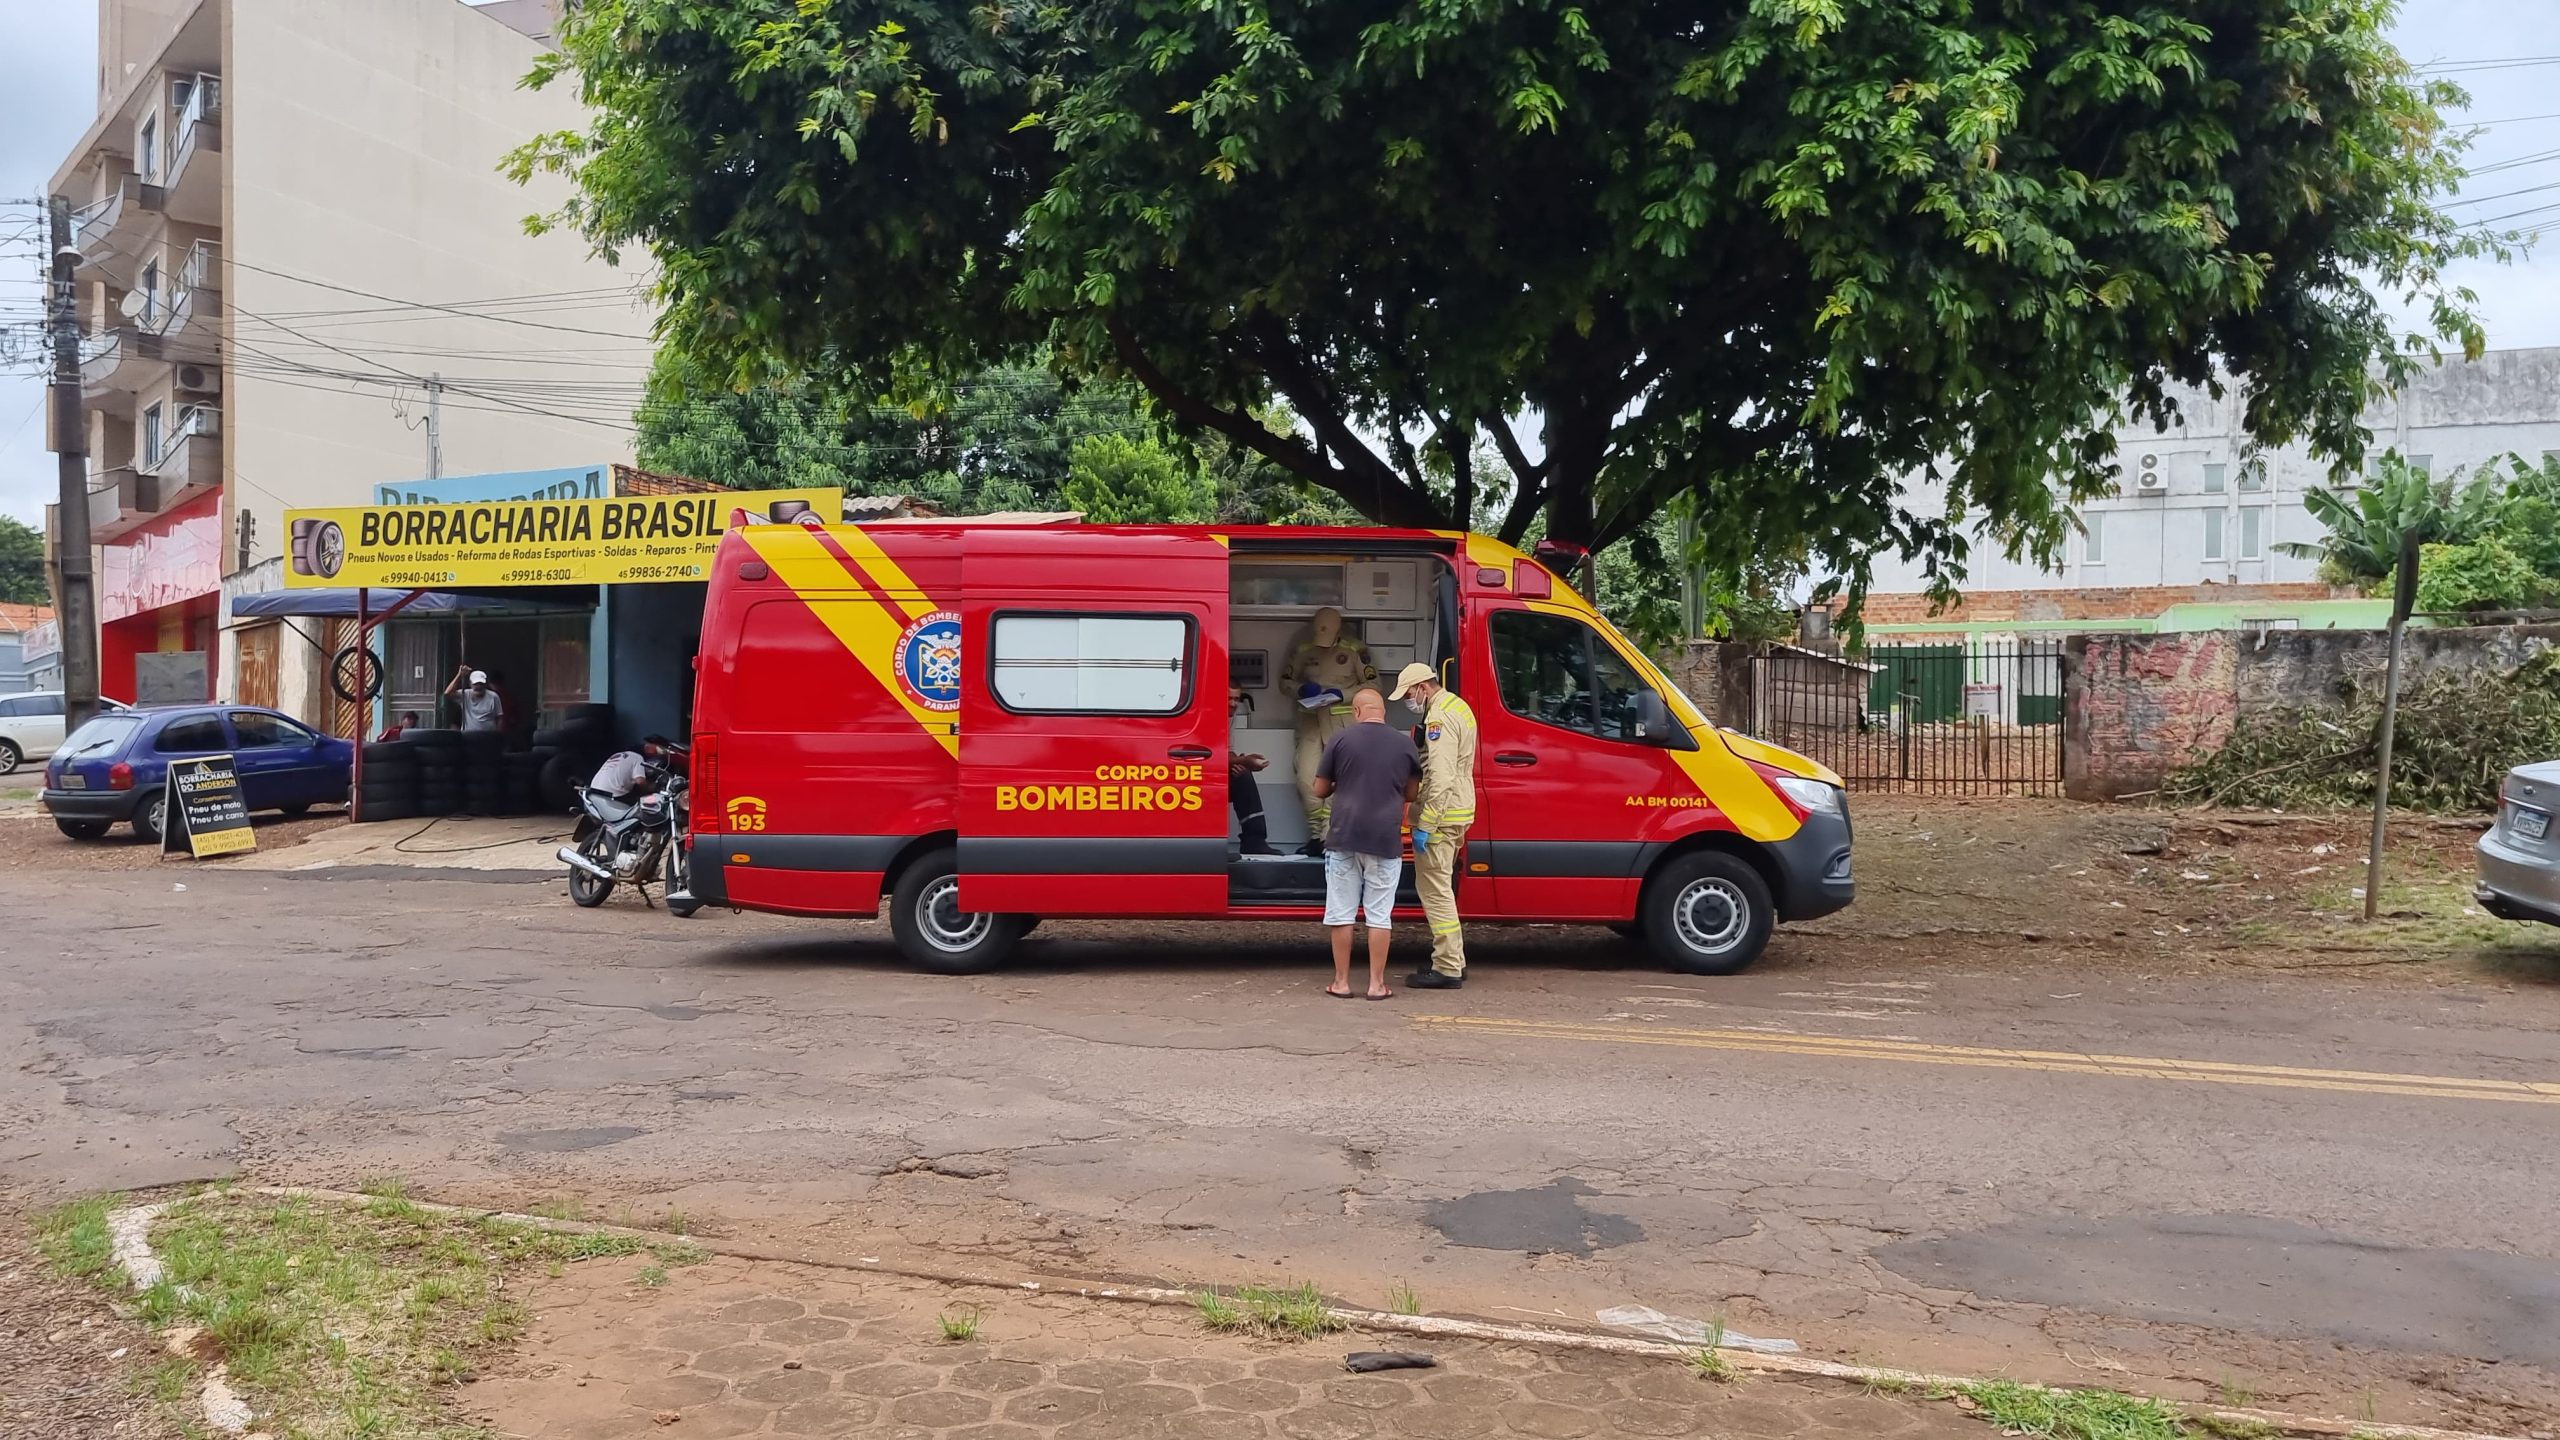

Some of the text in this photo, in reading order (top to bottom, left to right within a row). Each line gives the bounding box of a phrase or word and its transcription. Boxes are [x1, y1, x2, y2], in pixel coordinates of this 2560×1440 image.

[360, 498, 724, 546] BORRACHARIA BRASIL
[347, 552, 376, 564] Pneus
[377, 551, 406, 563] Novos
[407, 553, 414, 562] e
[415, 549, 449, 562] Usados
[456, 548, 497, 561] Reforma
[498, 549, 511, 560] de
[512, 547, 542, 560] Rodas
[544, 547, 597, 561] Esportivas
[603, 545, 638, 558] Soldas
[645, 544, 687, 558] Reparos
[380, 571, 449, 584] 45 99940-0413
[500, 568, 571, 582] 45 99918-6300
[618, 565, 692, 579] 45 99836-2740
[894, 638, 907, 676] CORPO
[905, 623, 919, 637] DE
[179, 772, 234, 784] BORRACHARIA
[1095, 765, 1203, 781] CORPO DE
[180, 779, 237, 792] DO ANDERSON
[996, 785, 1203, 811] BOMBEIROS
[1625, 796, 1708, 808] AA BM 00141
[189, 806, 209, 814] Pneu
[223, 801, 241, 809] moto
[191, 812, 244, 824] Pneu de carro
[728, 814, 766, 831] 193
